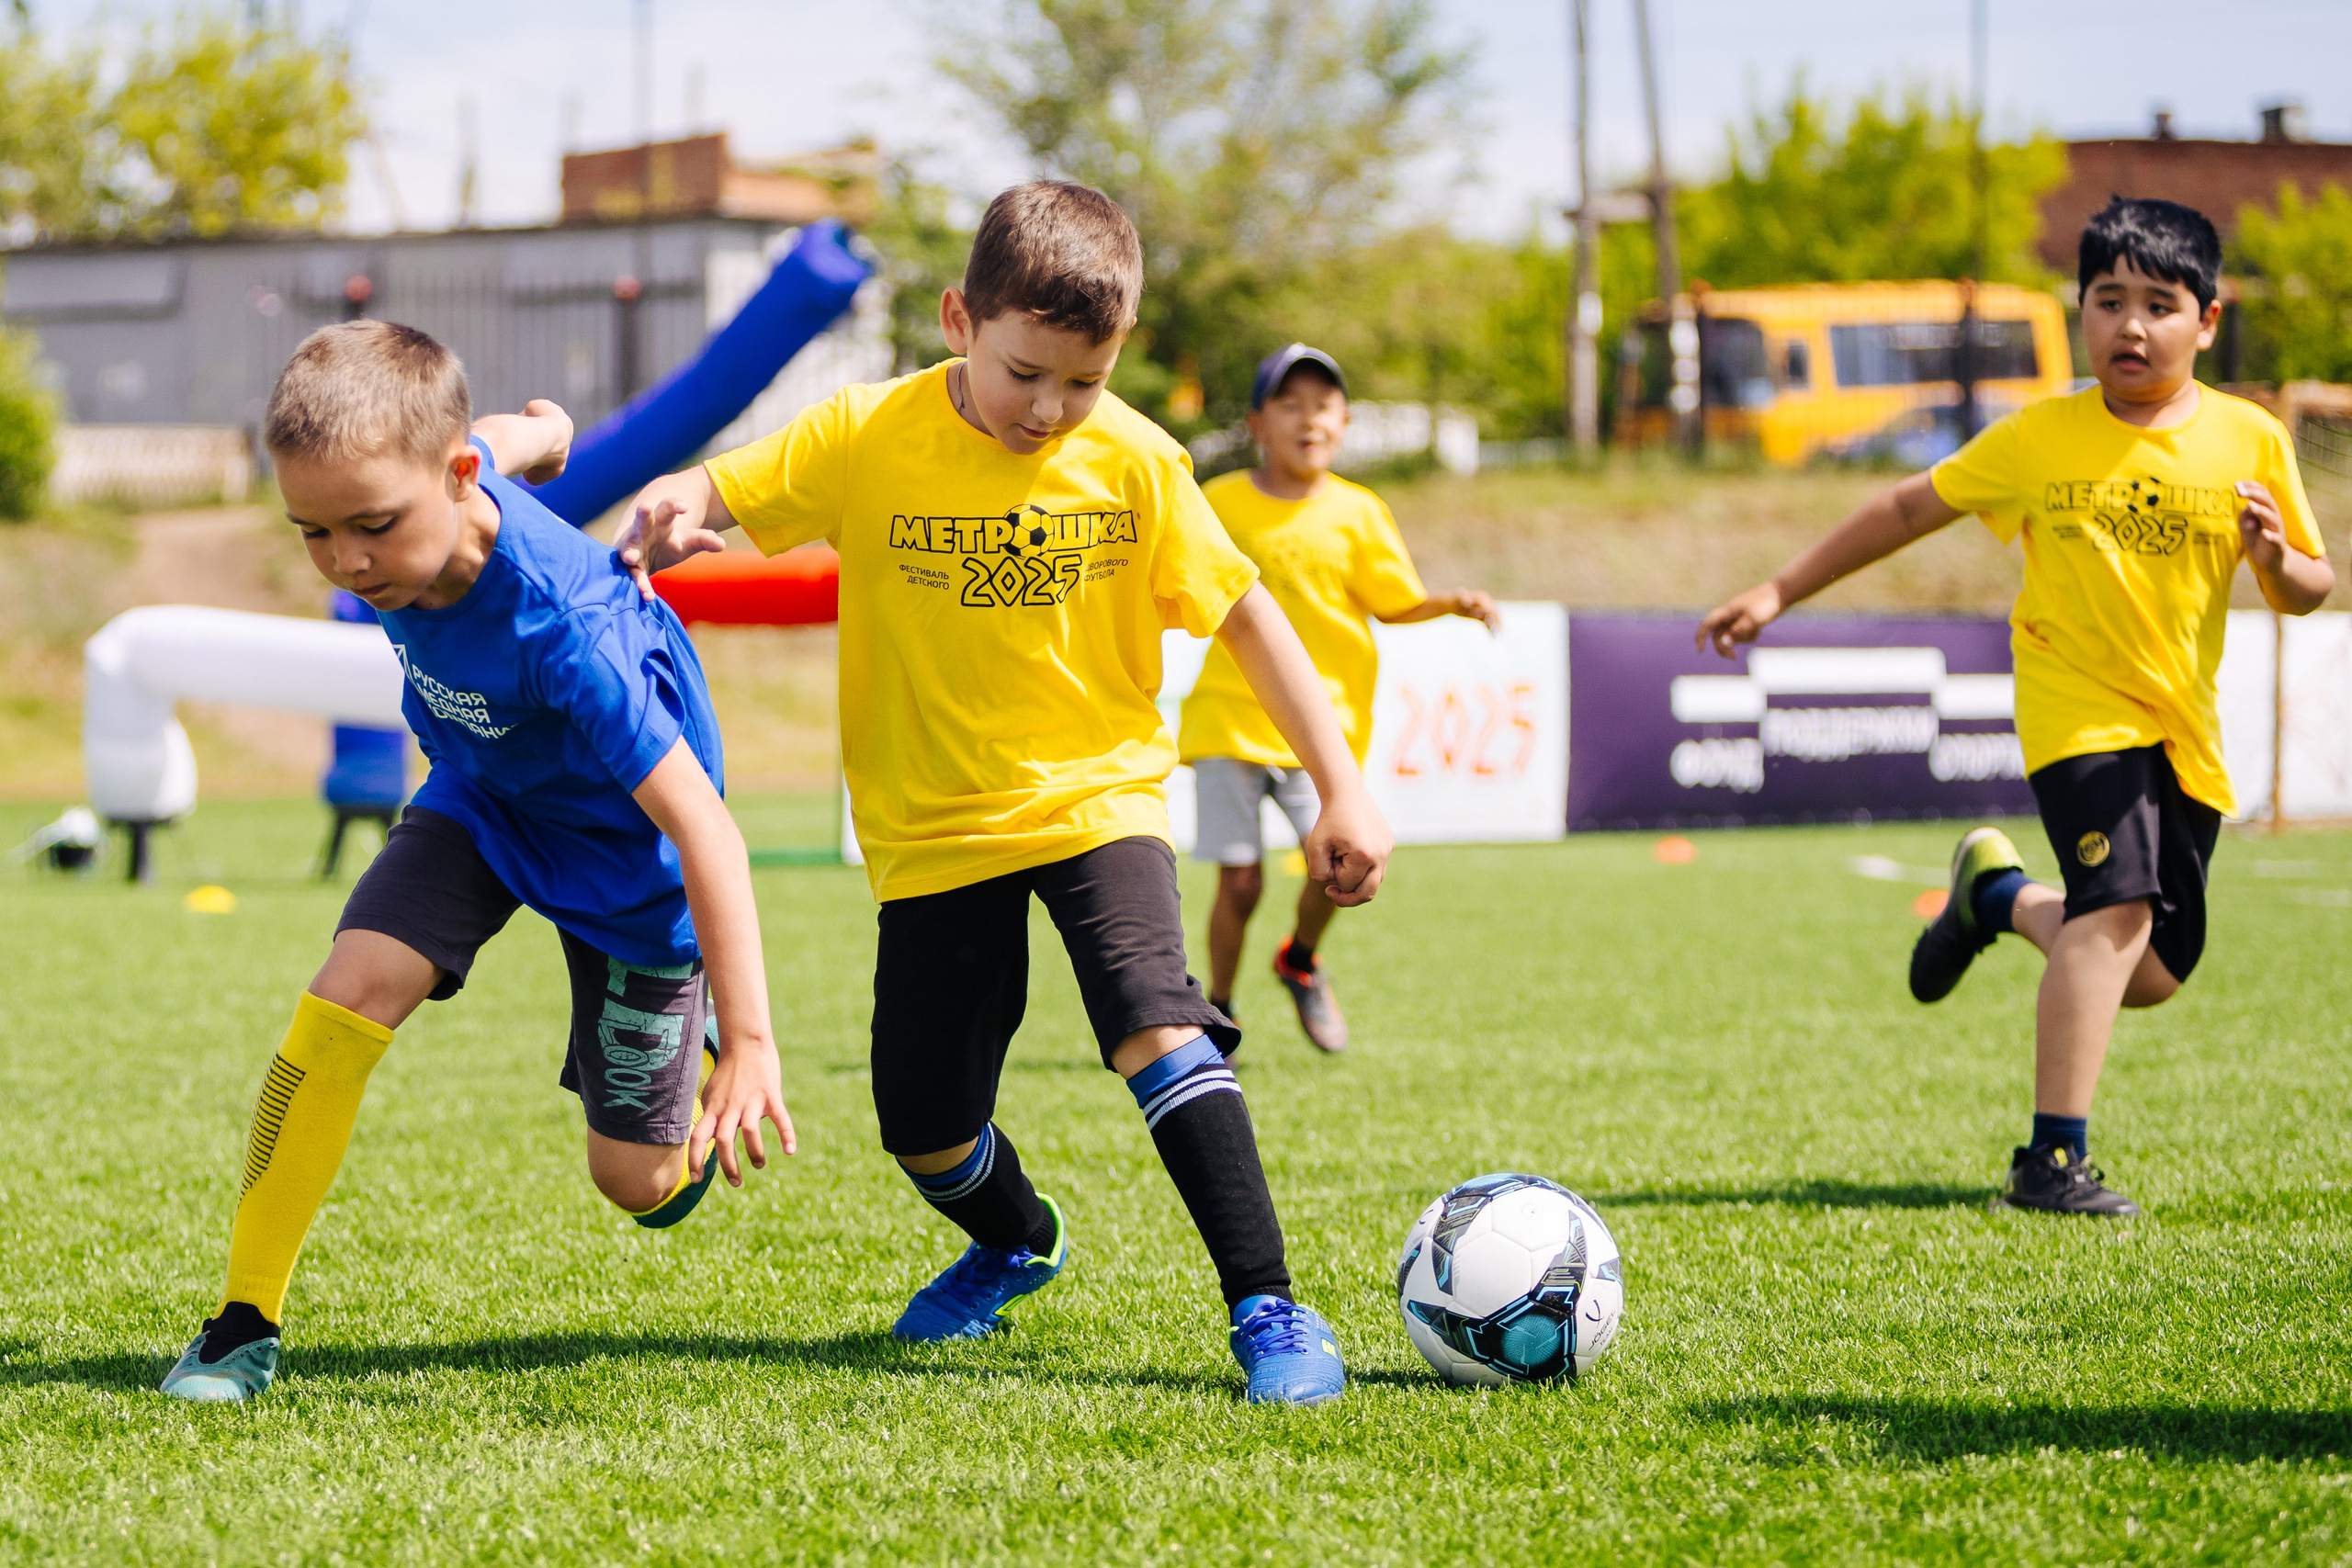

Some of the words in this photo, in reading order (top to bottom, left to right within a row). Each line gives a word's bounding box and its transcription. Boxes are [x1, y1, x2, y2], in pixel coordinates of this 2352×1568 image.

[2093, 512, 2188, 557] 2025
[899, 564, 950, 581] ФЕСТИВАЛЬ
[907, 575, 950, 591] ДЕТСКОГО
[961, 553, 1082, 606] 2025
[412, 663, 487, 706] РУССКАЯ
[1392, 682, 1538, 778] 2025
